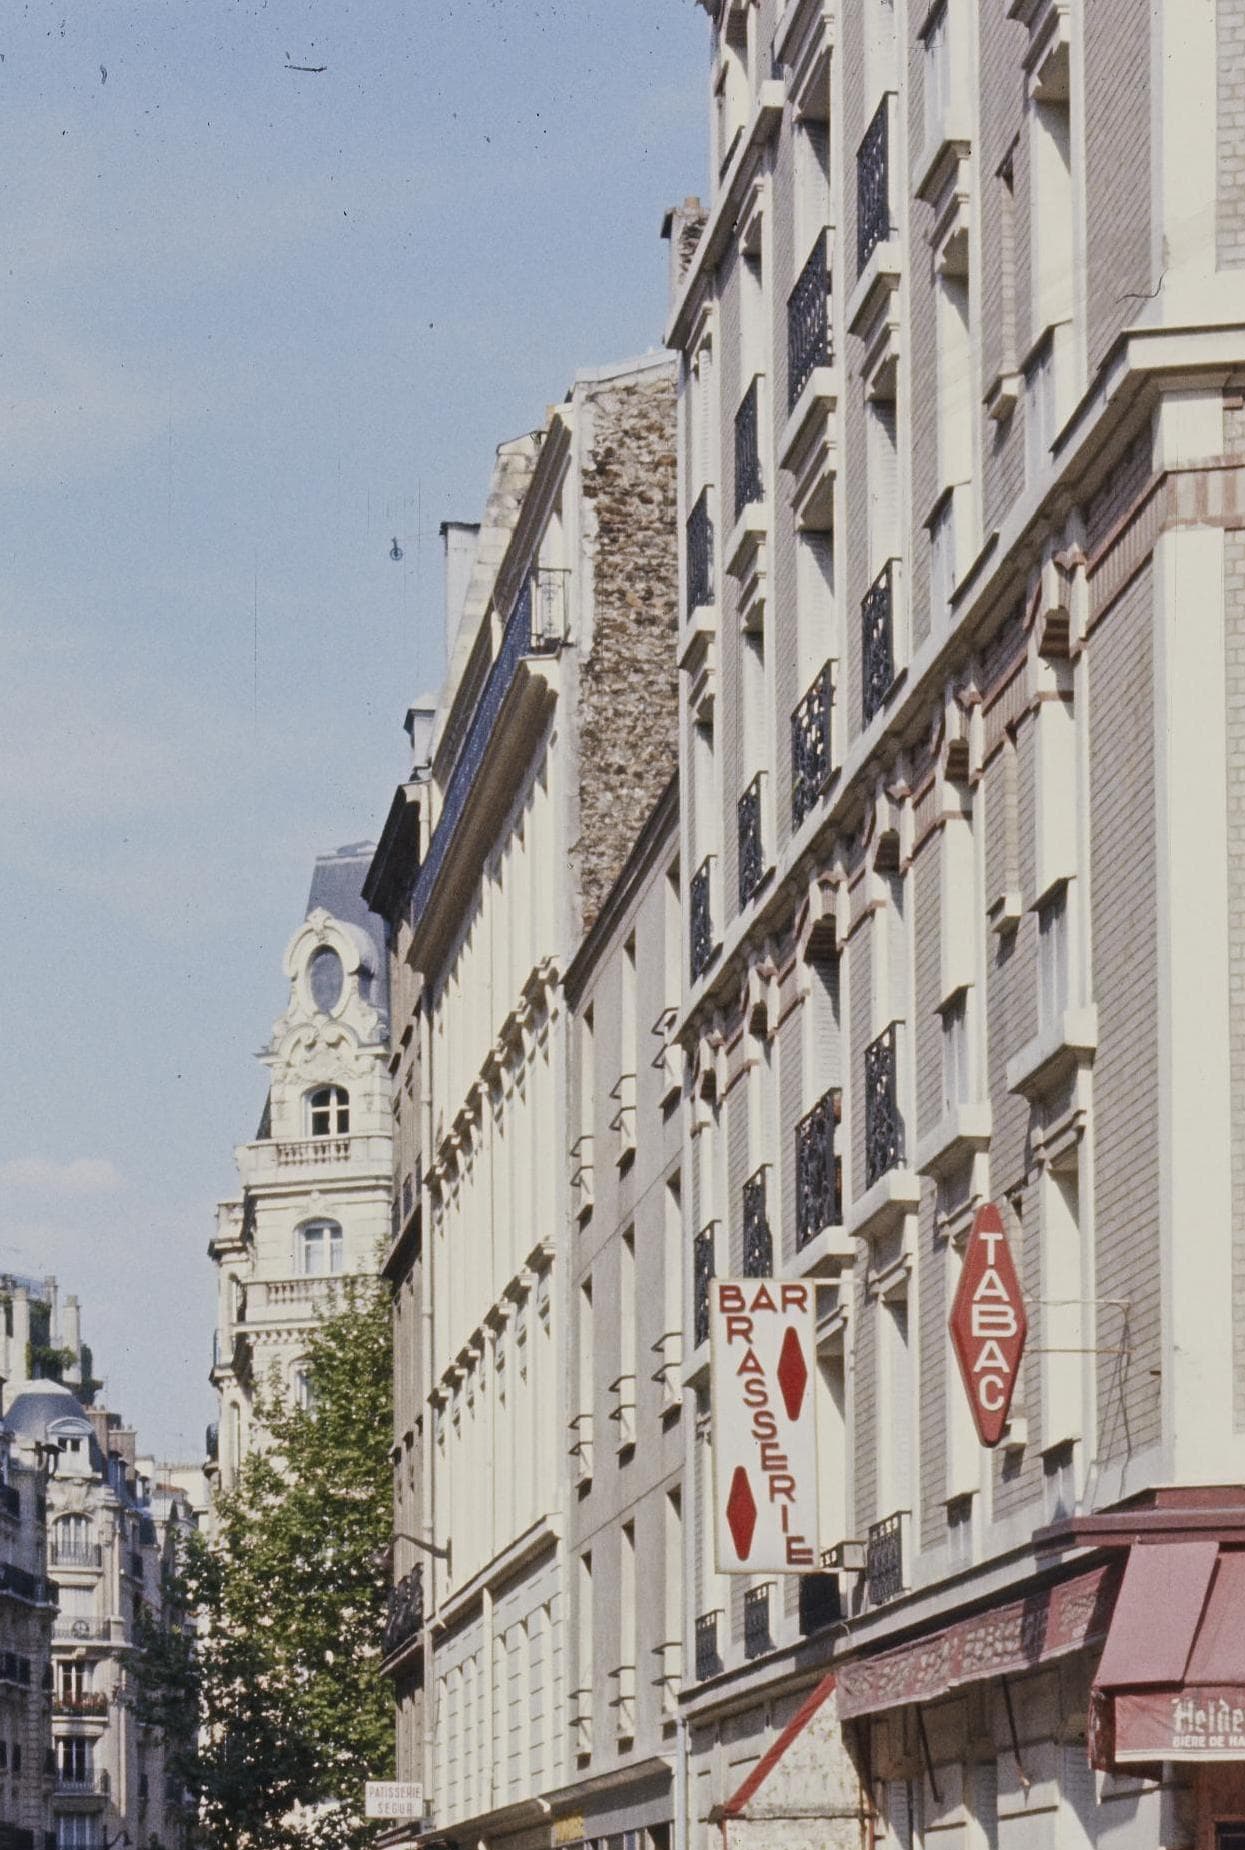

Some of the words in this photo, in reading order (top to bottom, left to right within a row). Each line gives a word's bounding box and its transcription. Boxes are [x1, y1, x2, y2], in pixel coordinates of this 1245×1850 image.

[718, 1283, 809, 1314] BAR
[970, 1231, 1018, 1412] TABAC
[1209, 1735, 1225, 1747] DE
